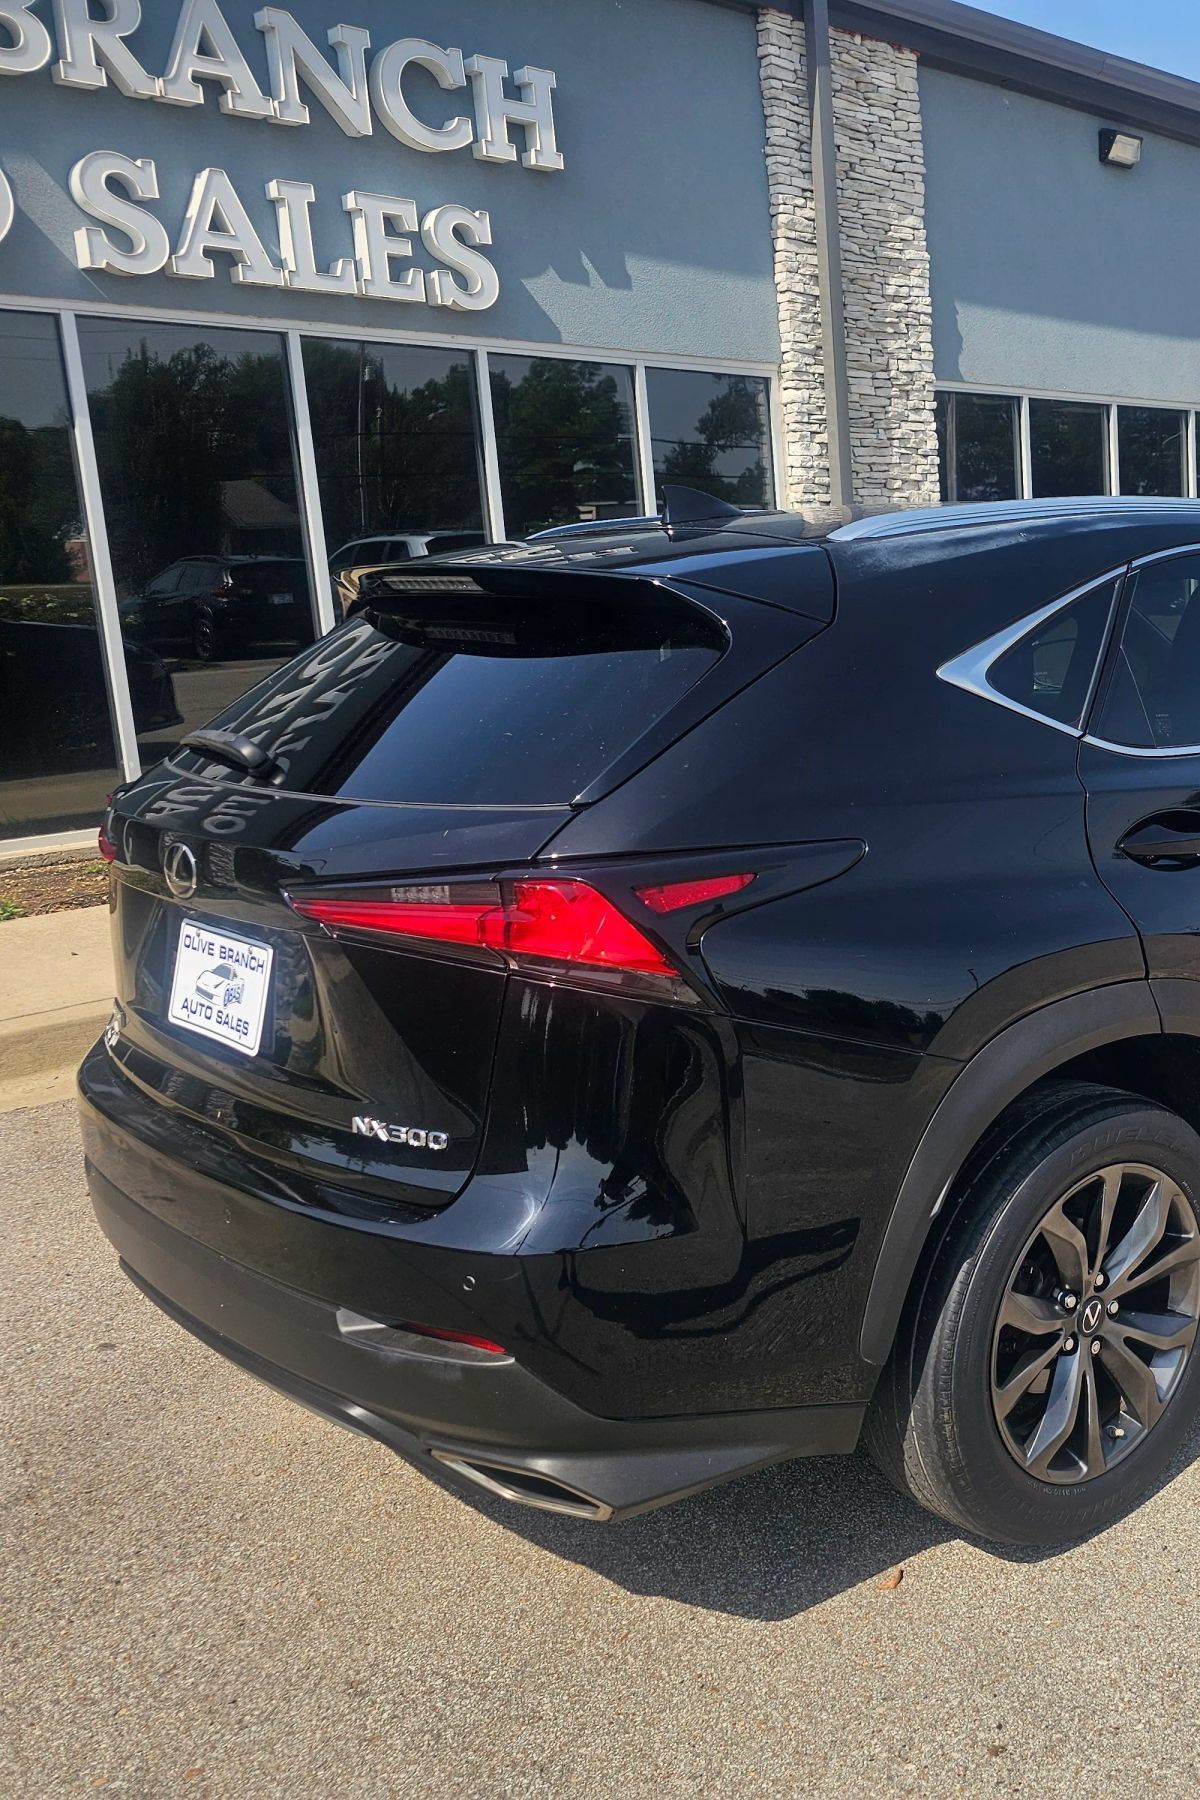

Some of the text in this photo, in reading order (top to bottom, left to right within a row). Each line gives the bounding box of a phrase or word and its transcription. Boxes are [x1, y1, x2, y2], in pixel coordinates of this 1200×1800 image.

[69, 150, 500, 312] SALES
[183, 934, 265, 975] OLIVE BRANCH
[180, 997, 250, 1036] AUTO SALES
